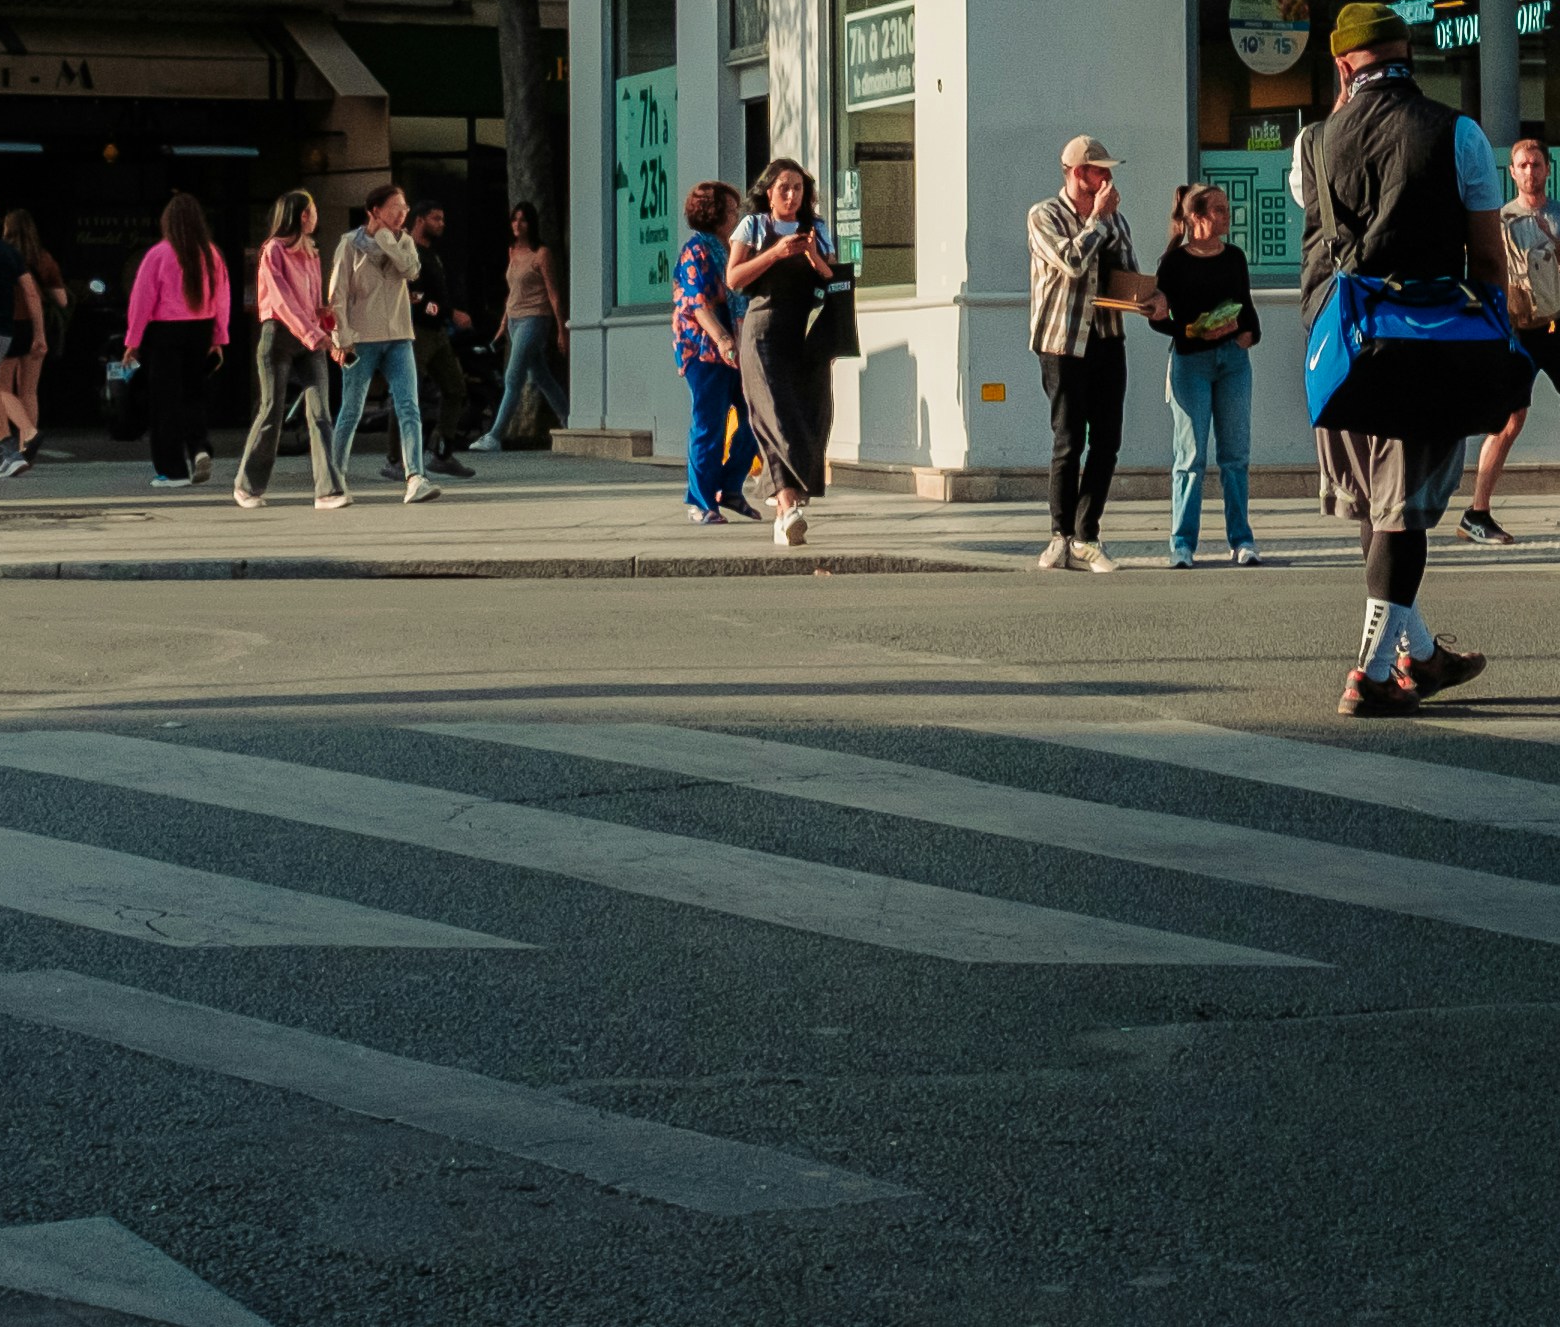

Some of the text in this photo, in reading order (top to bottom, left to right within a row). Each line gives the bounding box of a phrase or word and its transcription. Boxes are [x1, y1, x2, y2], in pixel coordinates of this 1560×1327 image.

[848, 26, 866, 67] 7h
[869, 23, 878, 63] à
[1434, 17, 1453, 50] DE
[1455, 13, 1480, 47] VOU
[854, 74, 861, 98] le
[861, 67, 897, 97] dimanche
[639, 85, 668, 148] 7h à
[639, 155, 668, 220] 23h
[645, 225, 669, 244] dimanche
[657, 249, 669, 285] 9h
